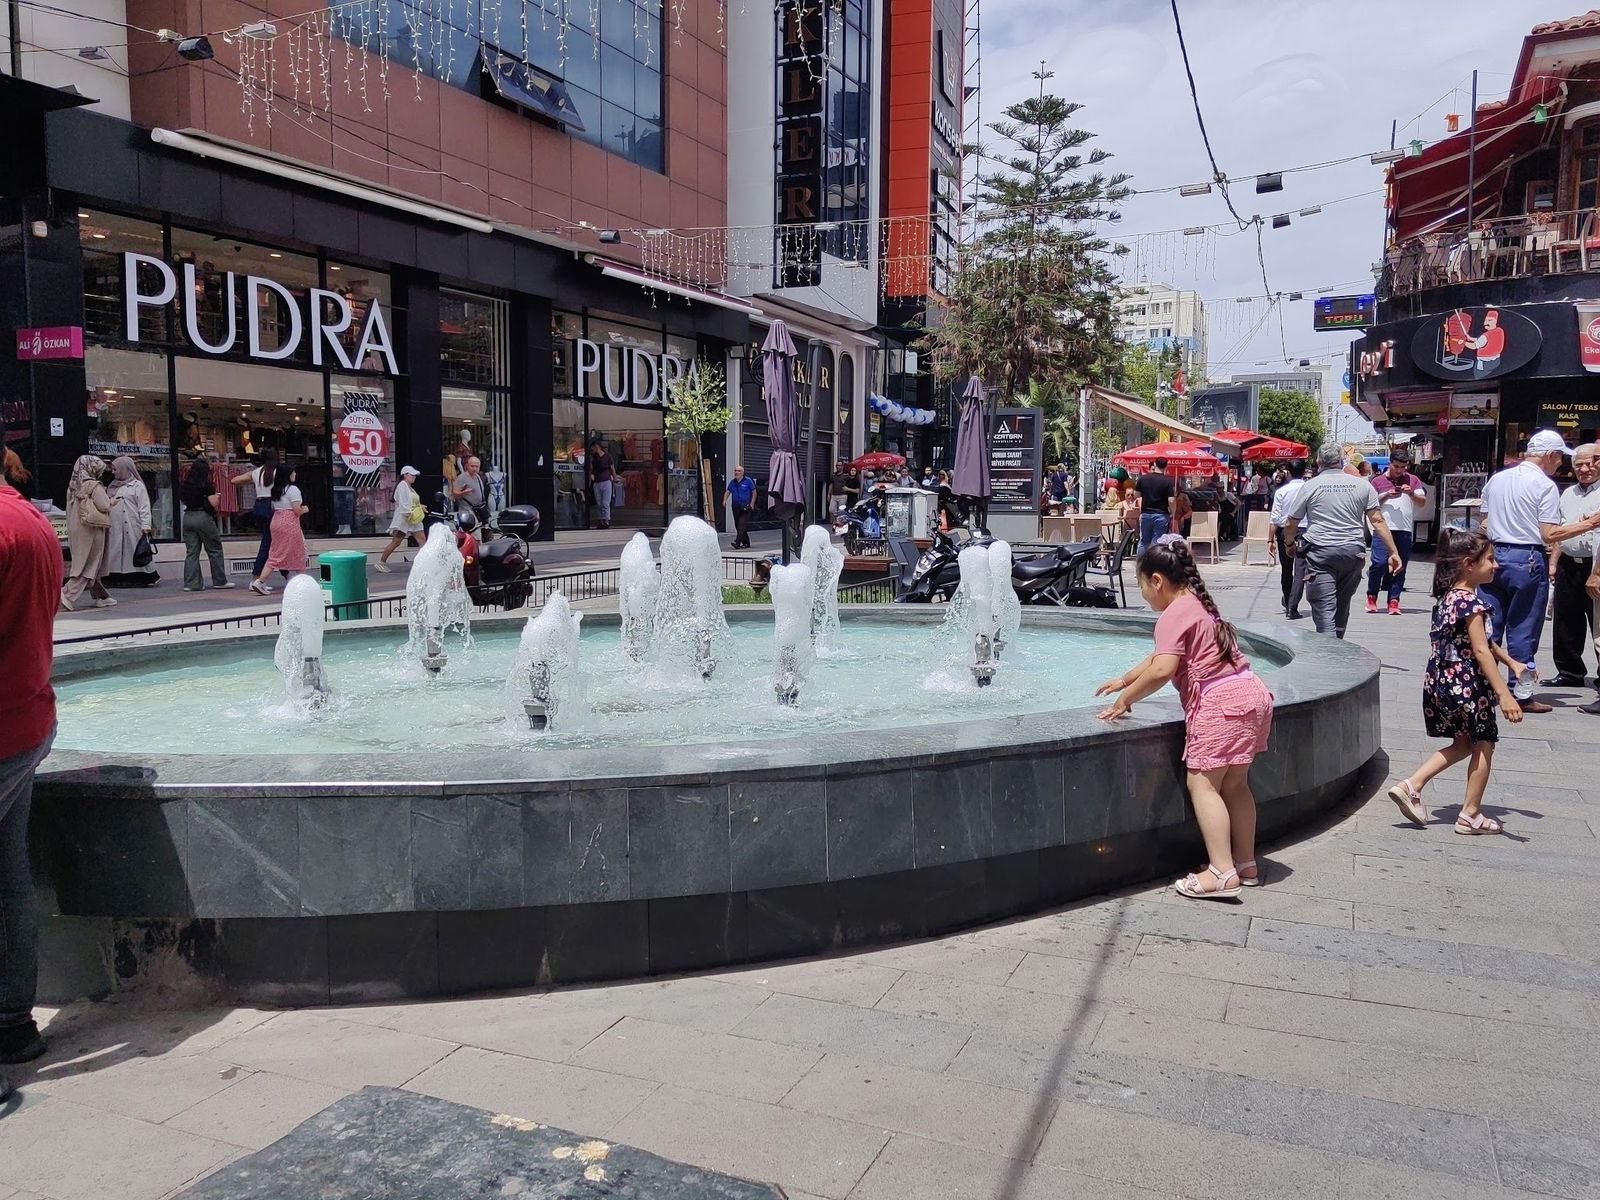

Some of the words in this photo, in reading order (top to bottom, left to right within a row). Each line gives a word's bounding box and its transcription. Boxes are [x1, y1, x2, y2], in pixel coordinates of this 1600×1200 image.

[124, 251, 400, 375] PUDRA
[43, 337, 70, 349] ÖZKAN
[577, 338, 701, 408] PUDRA
[347, 398, 377, 408] PUDRA
[349, 415, 374, 424] SÜTYEN
[348, 457, 377, 466] İNDİRİM
